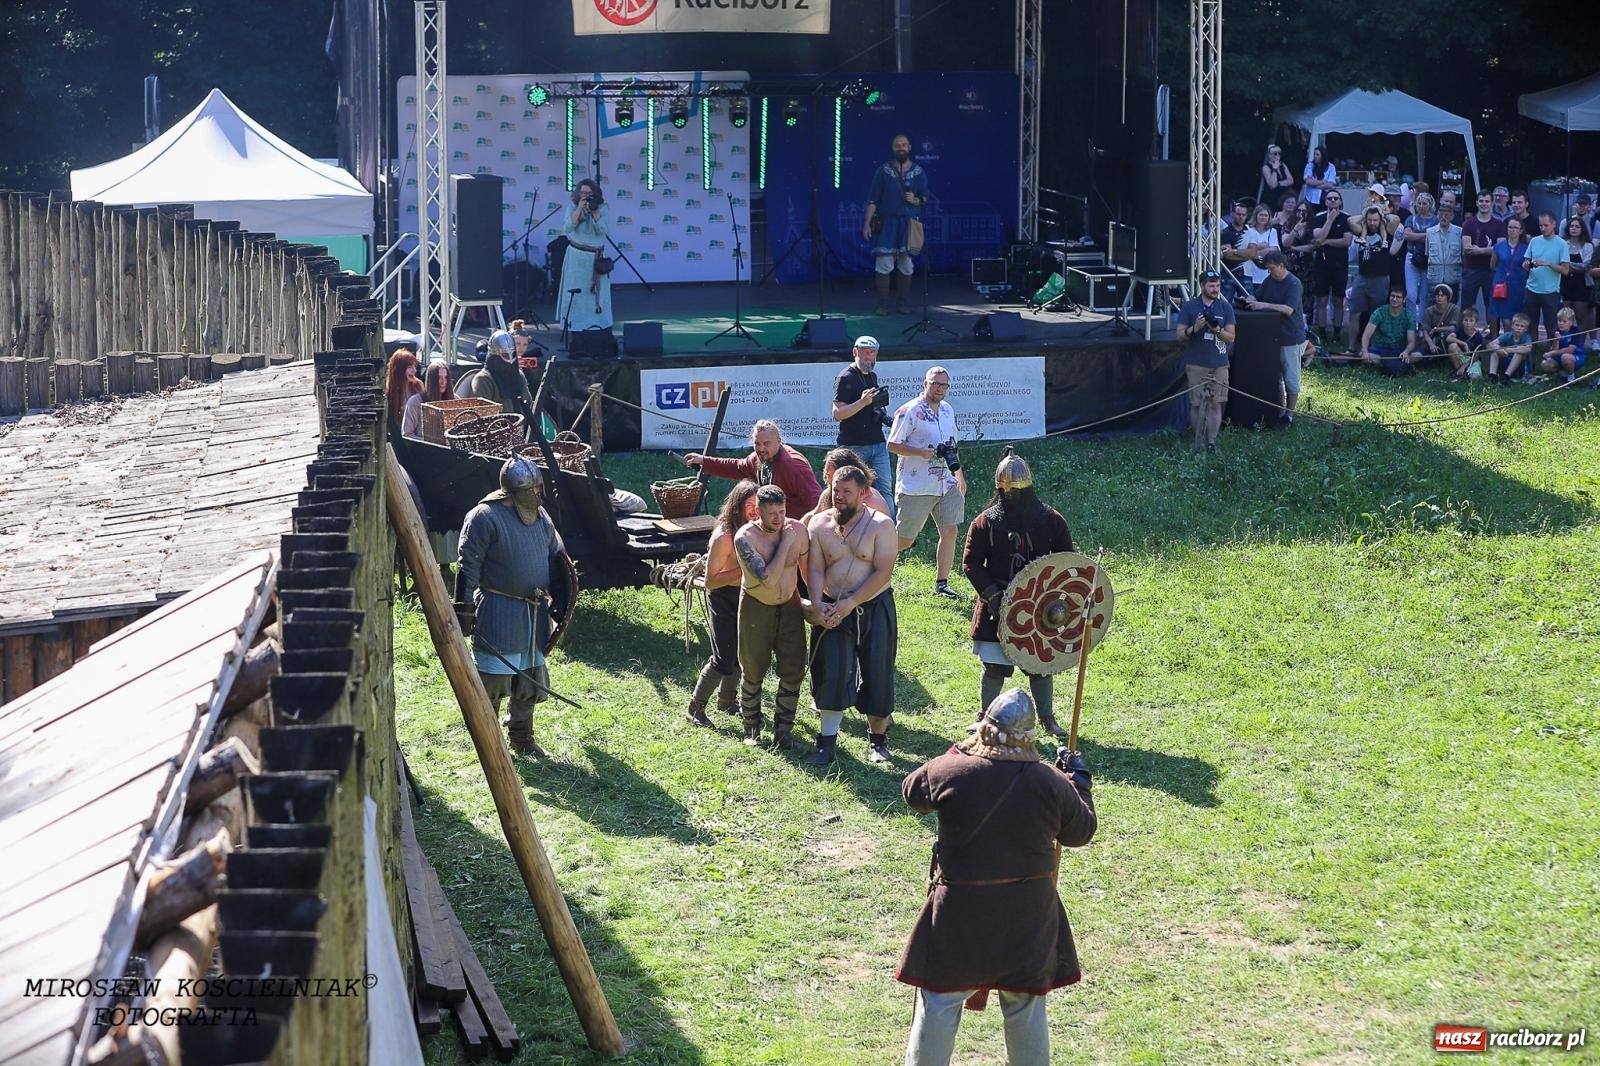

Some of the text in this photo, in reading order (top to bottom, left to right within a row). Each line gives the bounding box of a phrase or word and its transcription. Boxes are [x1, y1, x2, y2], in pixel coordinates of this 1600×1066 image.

[782, 379, 811, 387] HRANICE
[782, 387, 811, 395] GRANICE
[981, 388, 1032, 396] REGIONALNEGO
